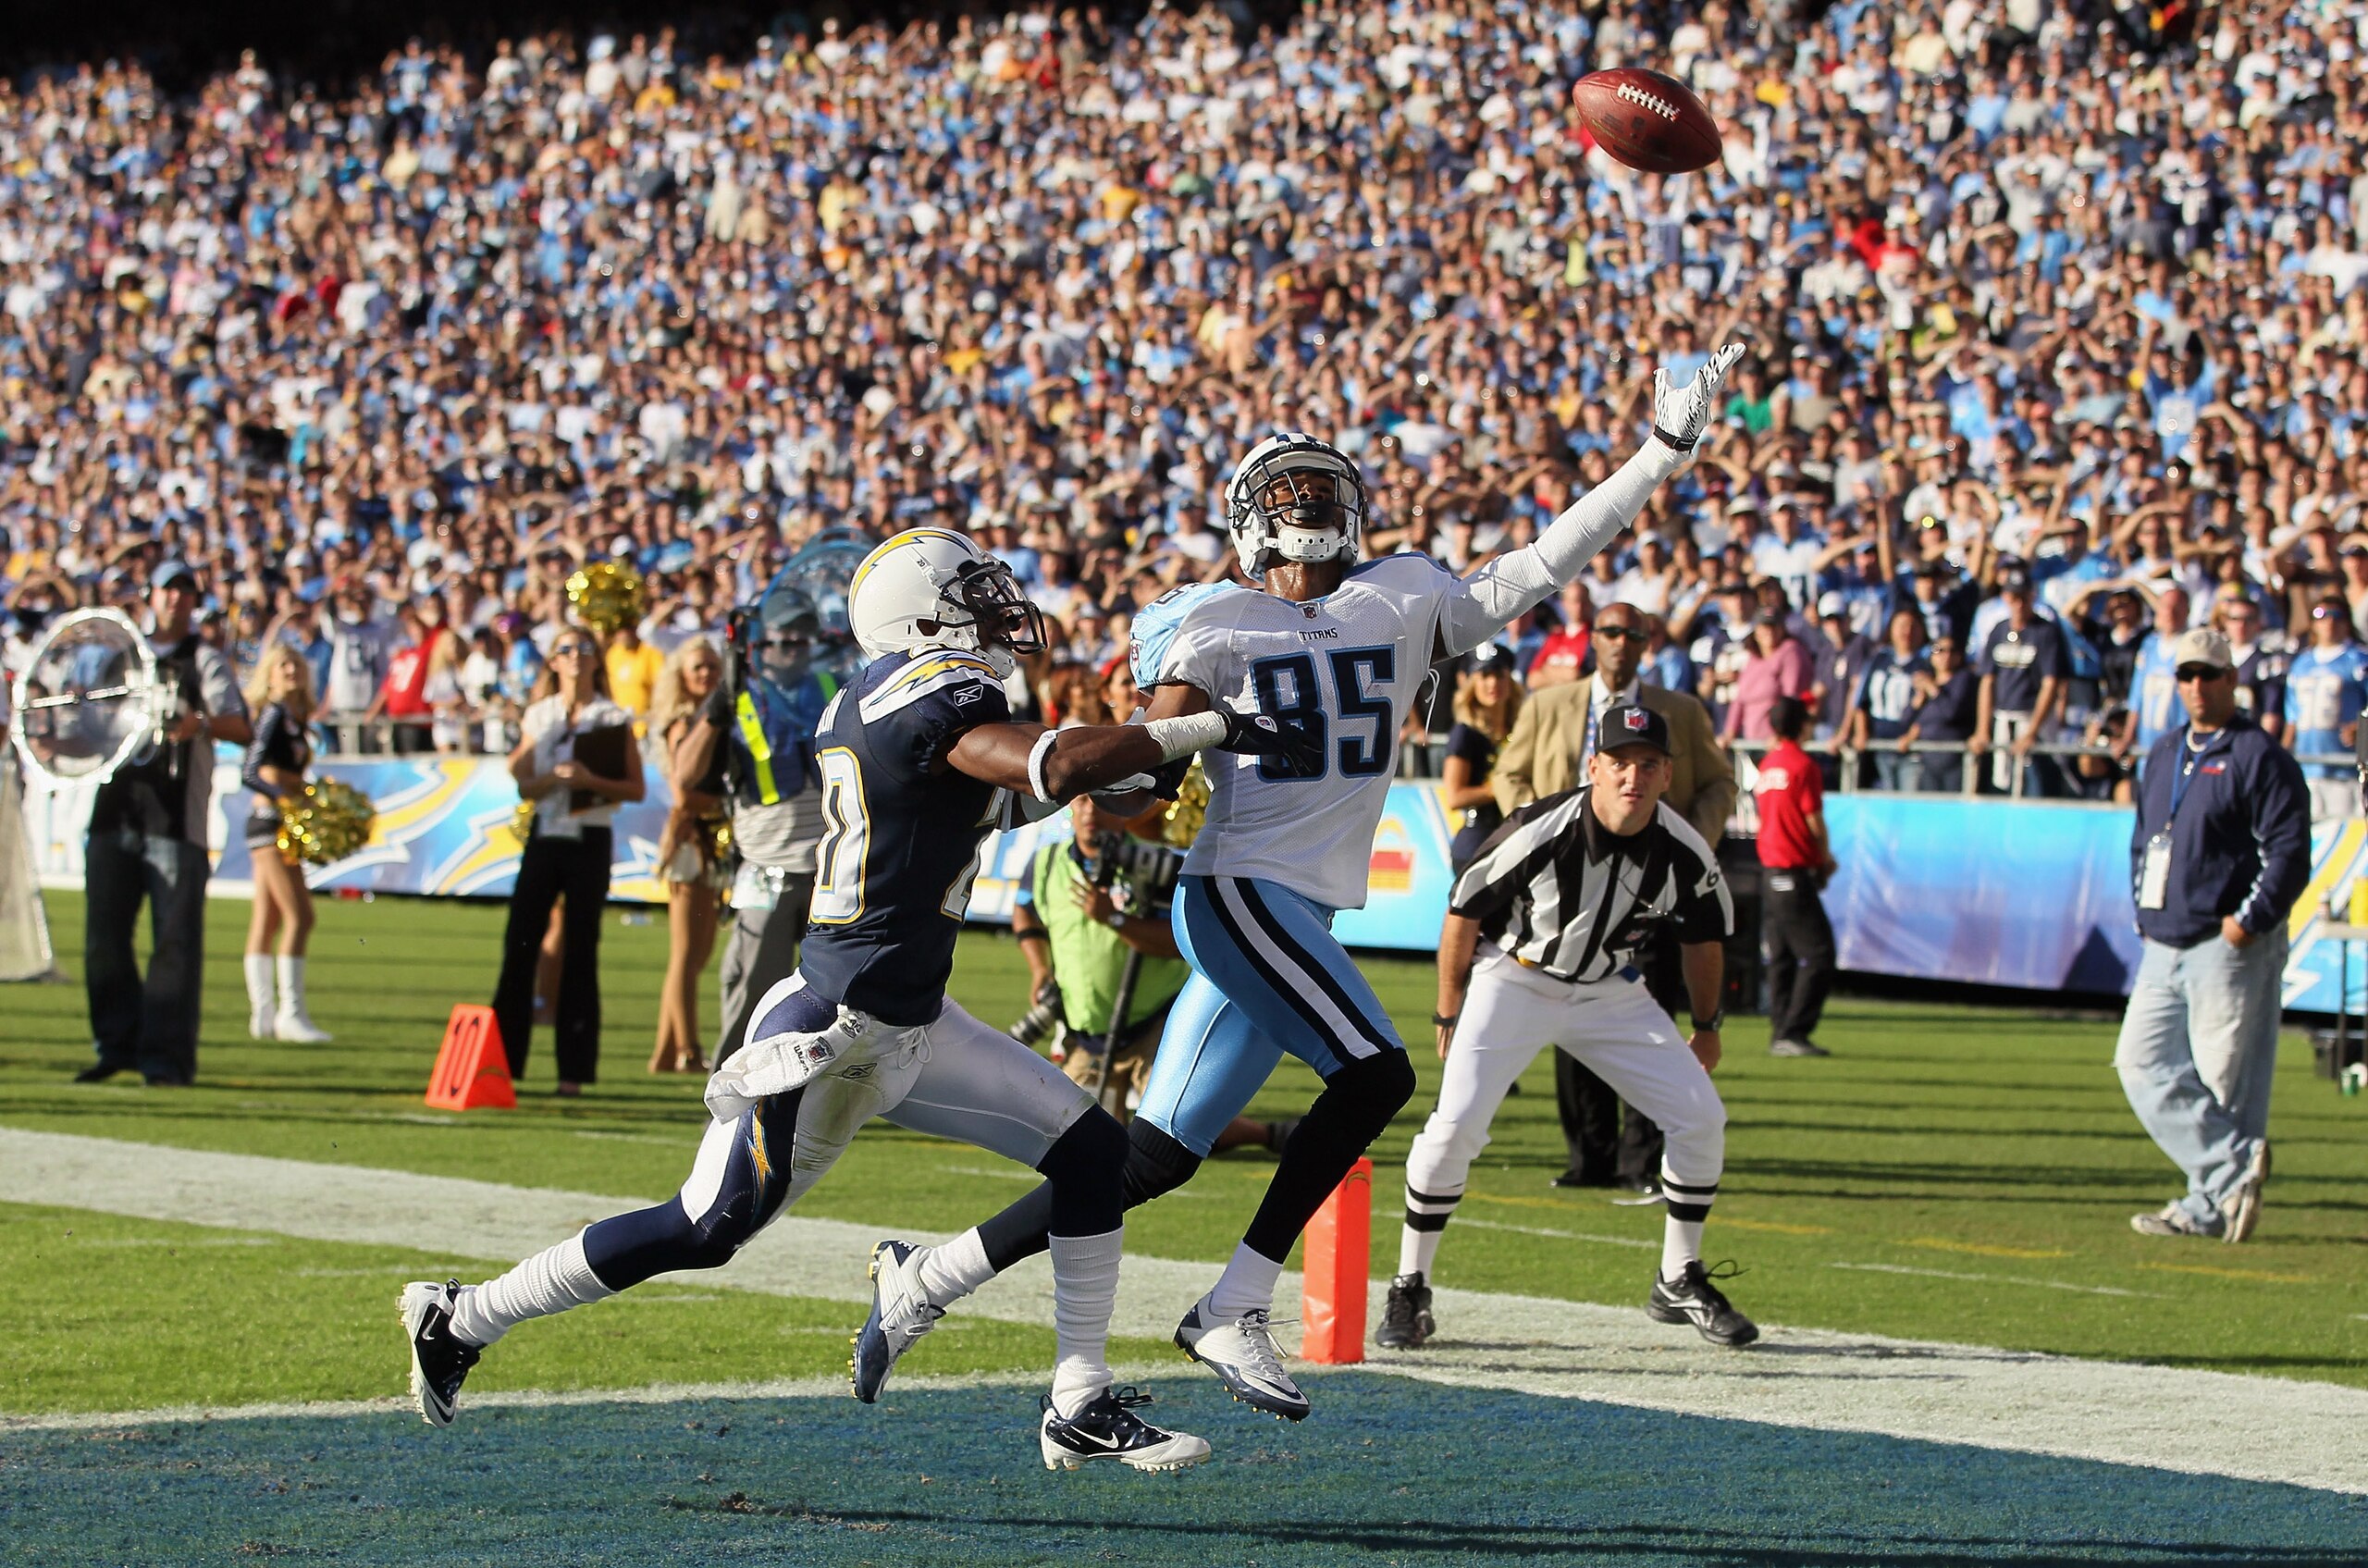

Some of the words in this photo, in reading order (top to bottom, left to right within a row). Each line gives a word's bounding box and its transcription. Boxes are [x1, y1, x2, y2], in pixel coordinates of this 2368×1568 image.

[917, 559, 926, 568] 20
[1299, 627, 1338, 641] TITANS
[1250, 644, 1395, 783] 85
[794, 1043, 810, 1077] Wilson
